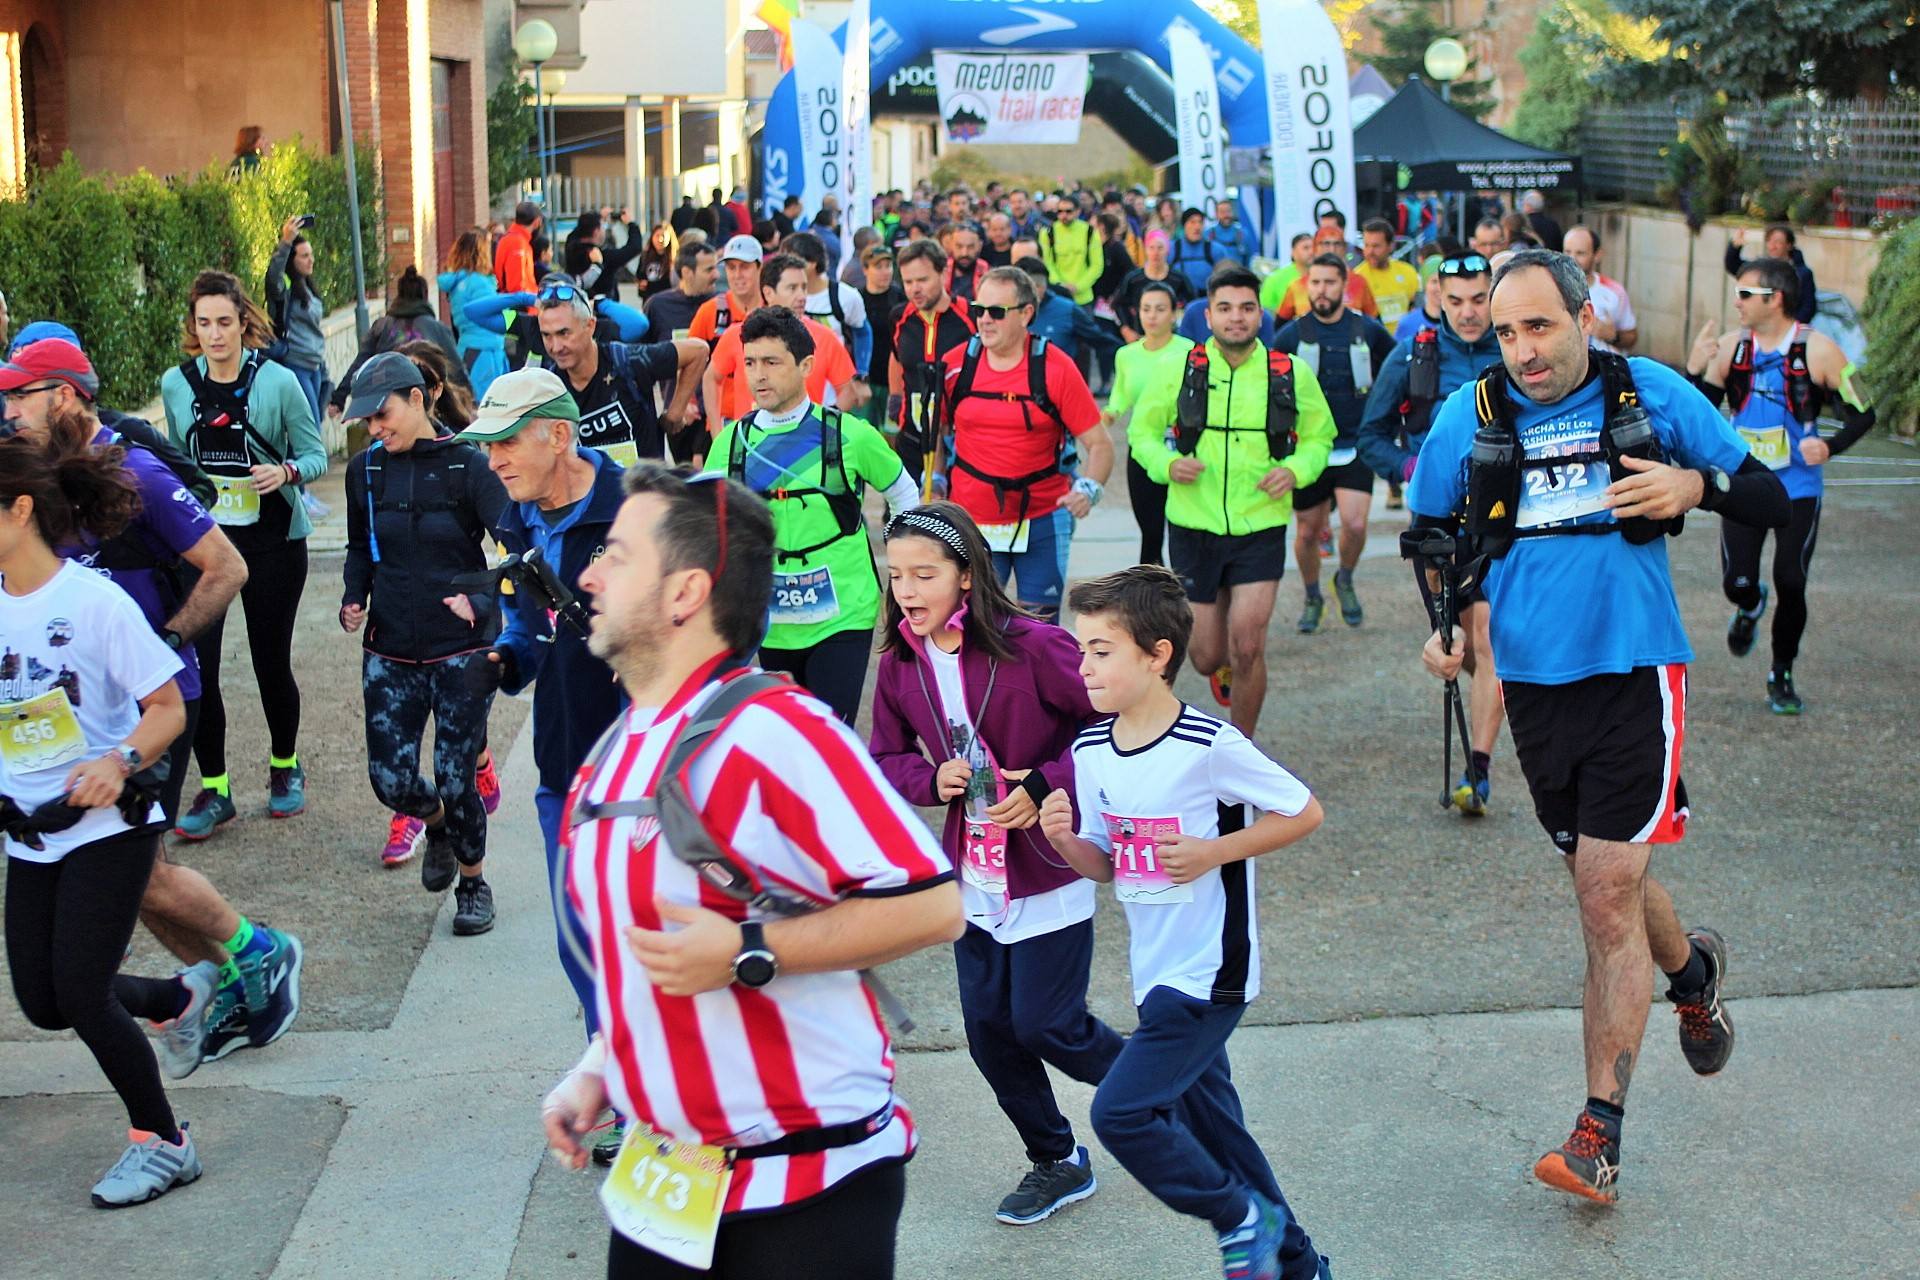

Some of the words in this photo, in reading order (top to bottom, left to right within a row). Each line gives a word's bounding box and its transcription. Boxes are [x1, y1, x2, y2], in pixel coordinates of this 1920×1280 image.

[955, 53, 1056, 91] medrano
[998, 94, 1035, 122] trail
[1040, 96, 1081, 121] race
[1520, 423, 1556, 437] ARCHA
[1558, 422, 1572, 431] DE
[1574, 420, 1593, 429] LOS
[1526, 463, 1588, 497] 252
[218, 493, 243, 509] 01
[776, 588, 818, 607] 264
[12, 718, 56, 744] 456
[1111, 841, 1156, 872] 711
[632, 1155, 691, 1211] 473
